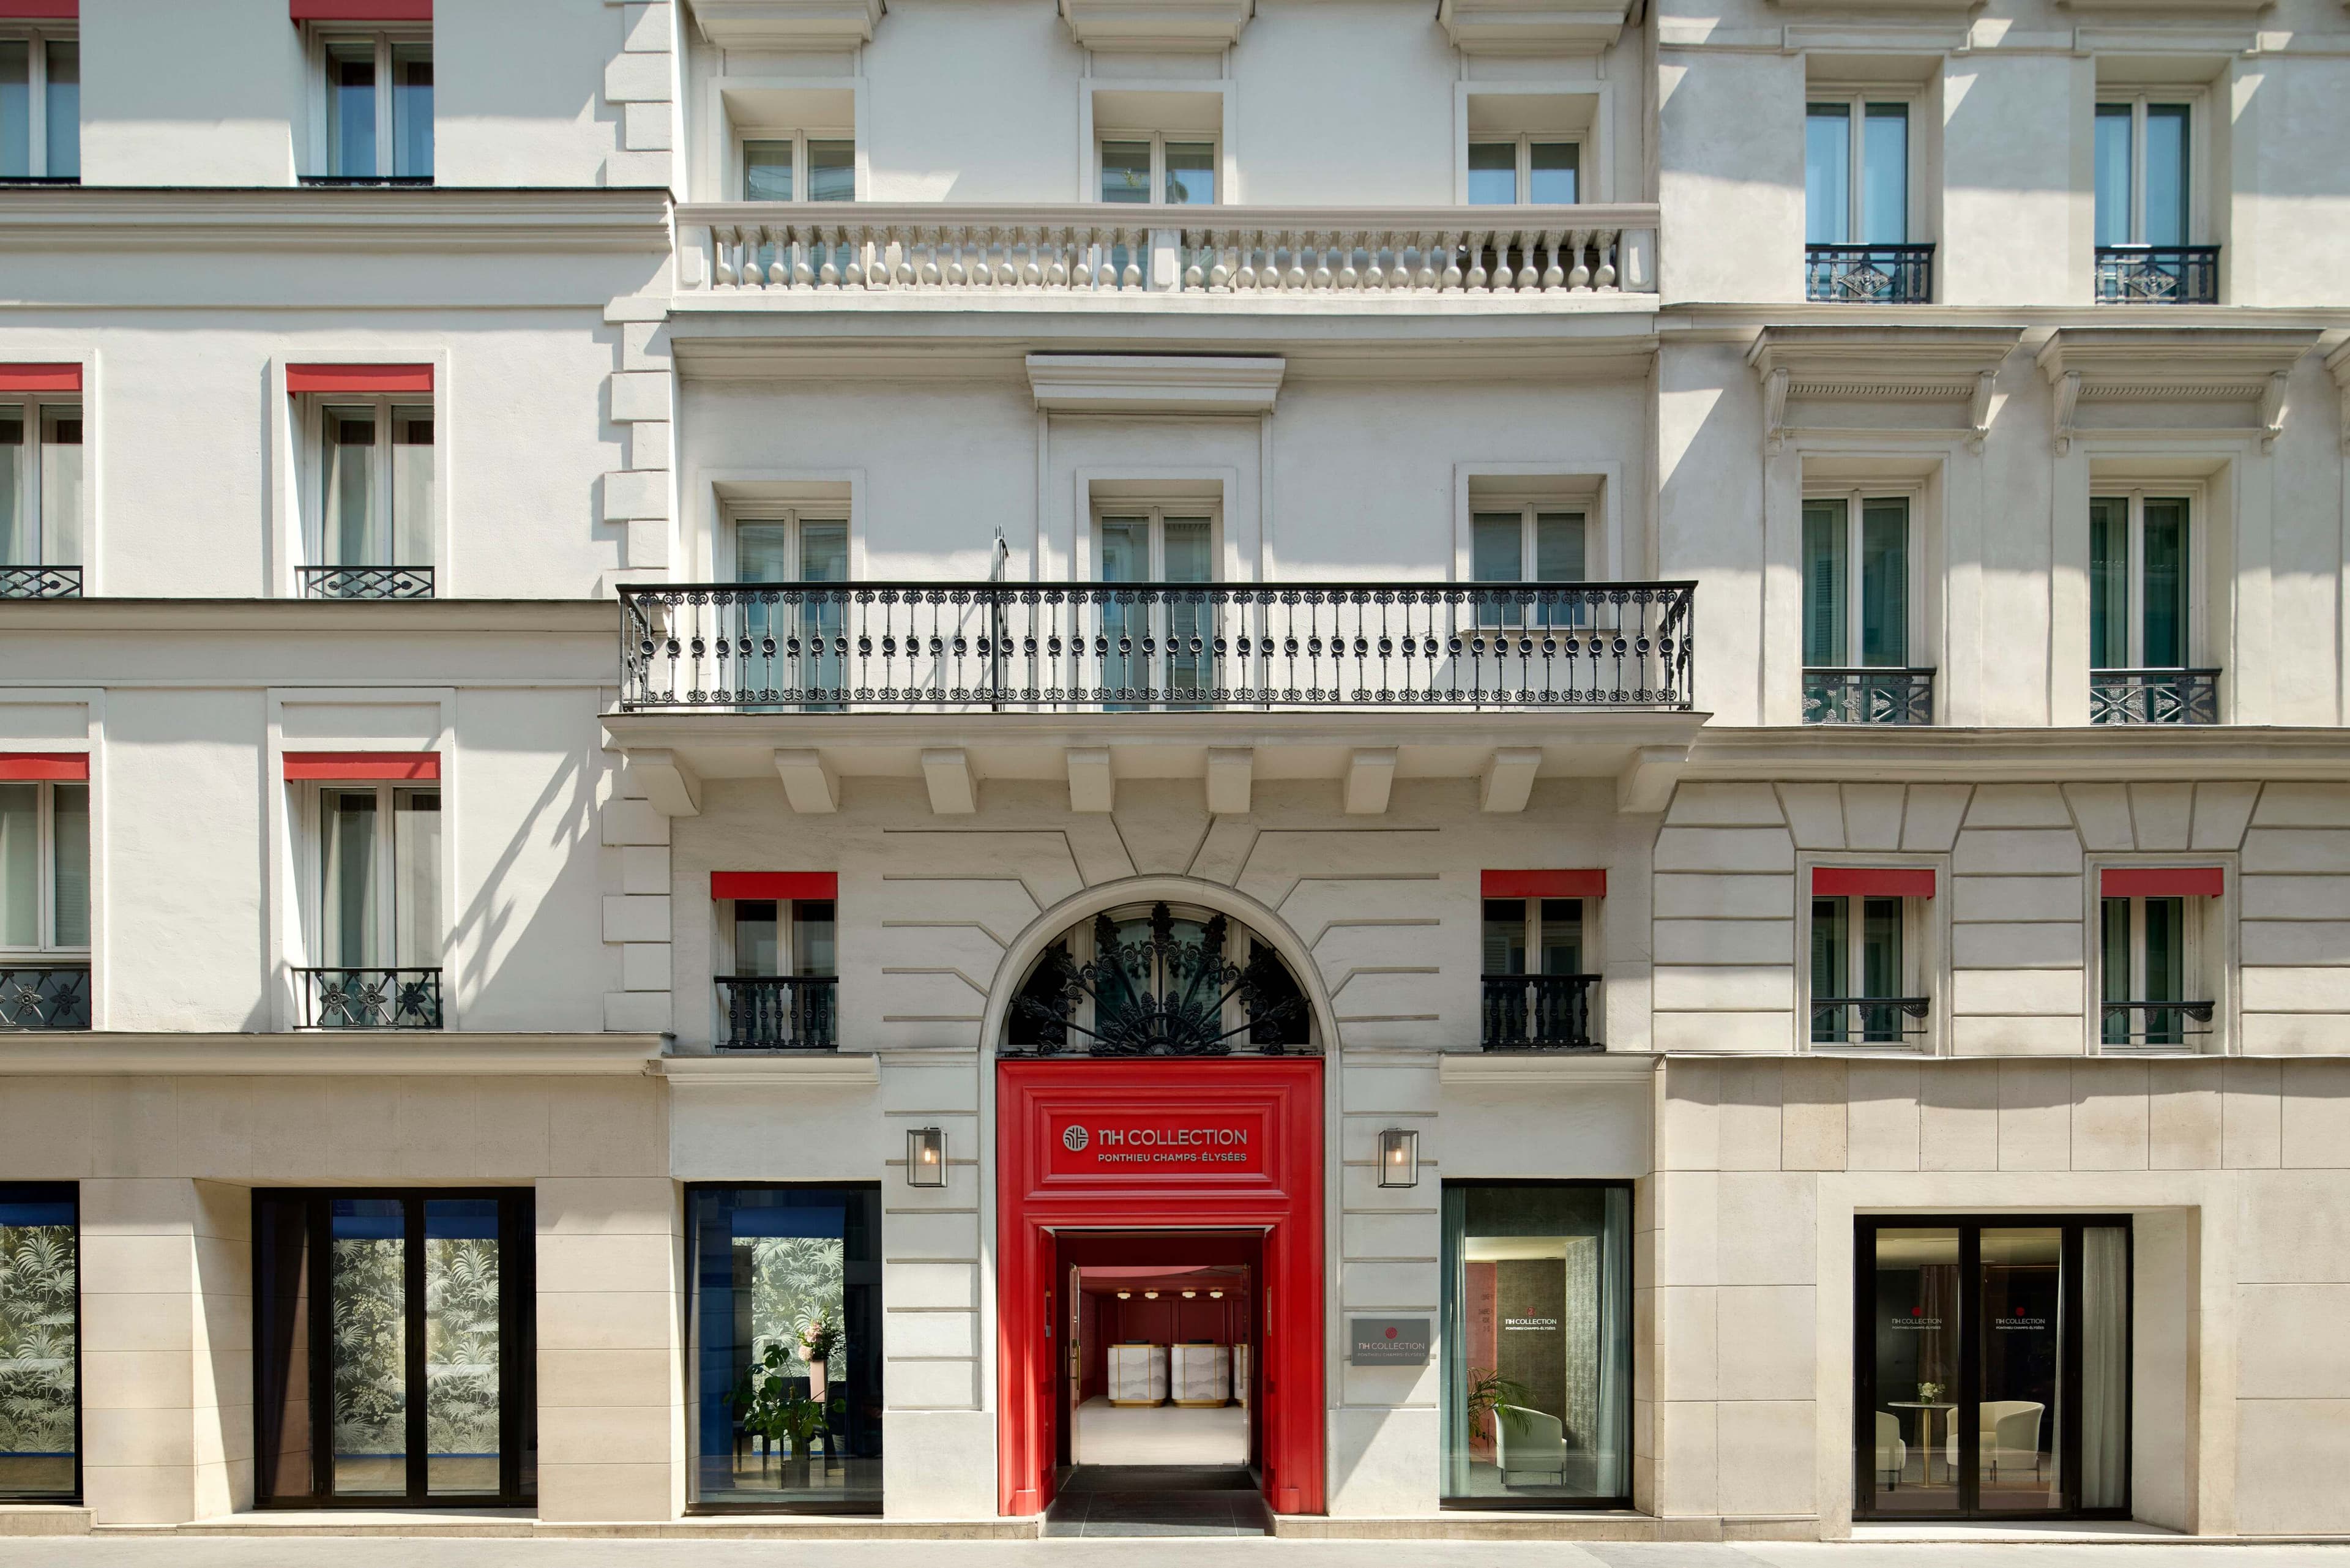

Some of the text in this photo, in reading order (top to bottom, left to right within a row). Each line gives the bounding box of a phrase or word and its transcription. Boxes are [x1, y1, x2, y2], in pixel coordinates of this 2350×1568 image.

[1128, 1129, 1247, 1146] COLLECTION
[1098, 1152, 1247, 1162] PONTHIEU CHAMPS-ÉLYSÉES
